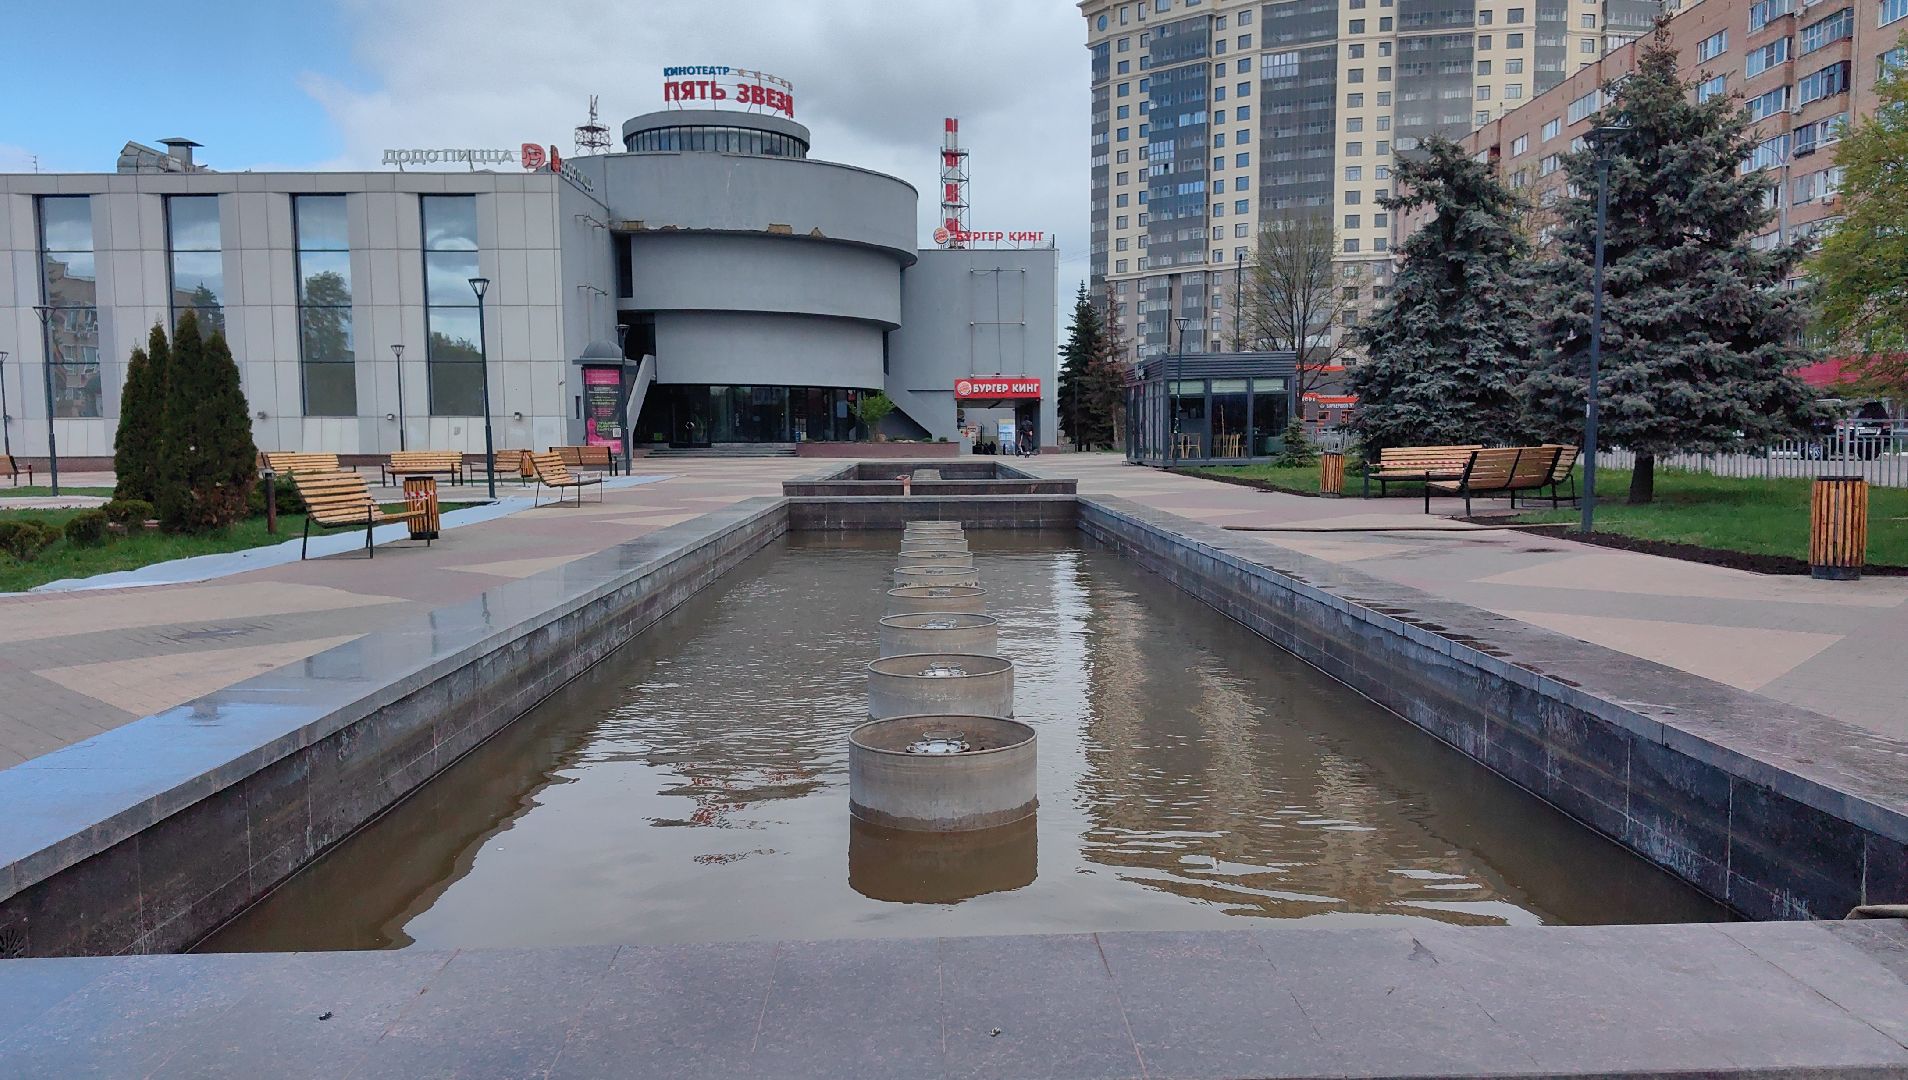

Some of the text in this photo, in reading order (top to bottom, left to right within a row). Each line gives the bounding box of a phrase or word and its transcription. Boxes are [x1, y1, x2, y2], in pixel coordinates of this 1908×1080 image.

[663, 66, 730, 77] КИНОТЕАТР
[664, 80, 727, 102] ПЯТЬ
[956, 231, 1004, 242] БУРГЕР
[1009, 231, 1045, 242] КИНГ
[973, 383, 1009, 394] БУРГЕР
[1012, 383, 1040, 394] КИНГ
